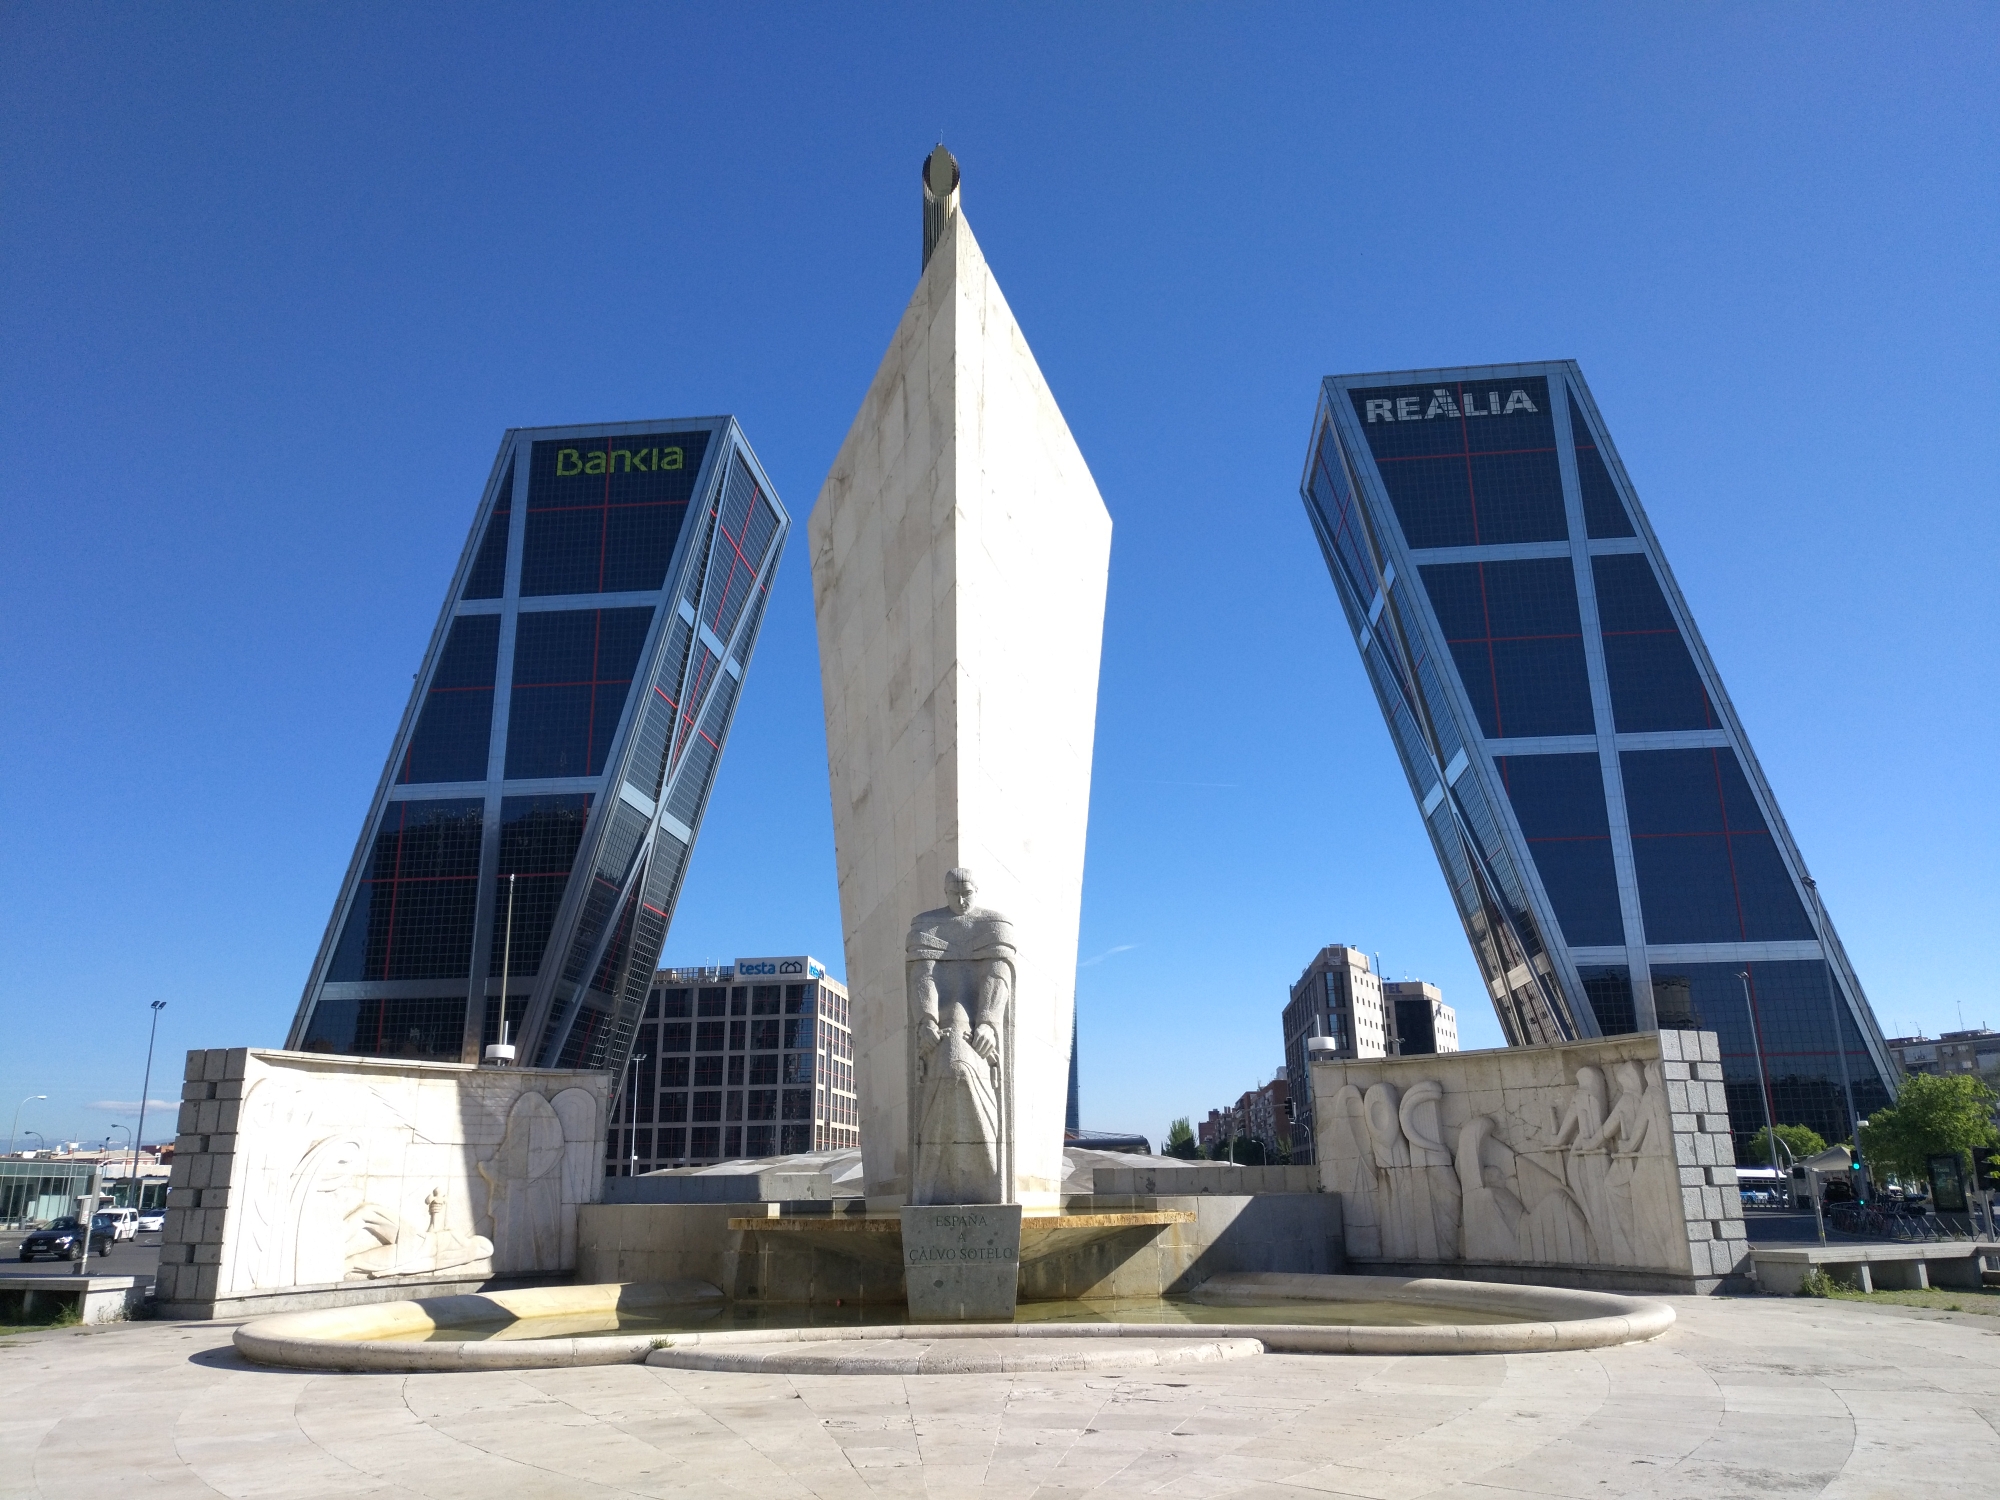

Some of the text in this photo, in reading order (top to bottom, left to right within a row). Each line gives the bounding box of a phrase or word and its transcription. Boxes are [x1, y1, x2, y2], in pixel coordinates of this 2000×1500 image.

[1365, 389, 1539, 423] REALIA
[556, 446, 684, 476] Bankia
[739, 962, 776, 975] testa
[936, 1213, 987, 1227] ESPAÑA
[957, 1232, 966, 1242] A
[909, 1249, 956, 1260] CALVO
[960, 1247, 1013, 1260] SOTELO
